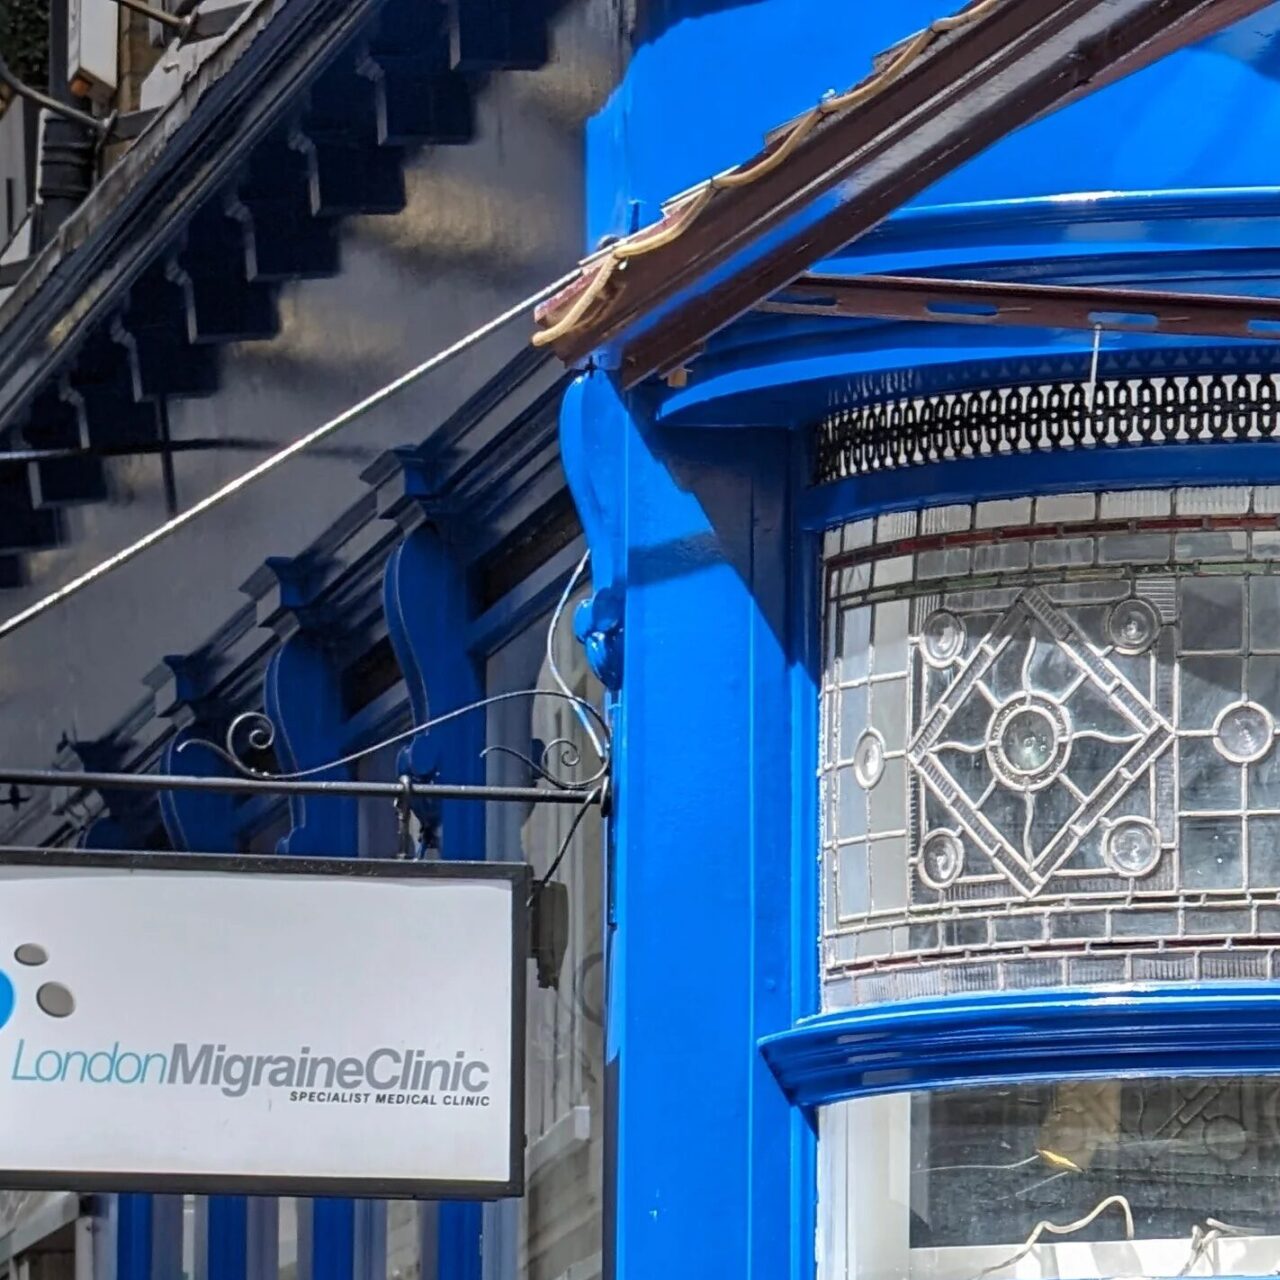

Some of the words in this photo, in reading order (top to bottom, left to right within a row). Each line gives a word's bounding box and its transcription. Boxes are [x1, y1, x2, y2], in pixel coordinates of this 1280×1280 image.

[290, 1091, 371, 1104] SPECIALIST
[375, 1093, 437, 1105] MEDICAL
[442, 1095, 490, 1106] CLINIC
